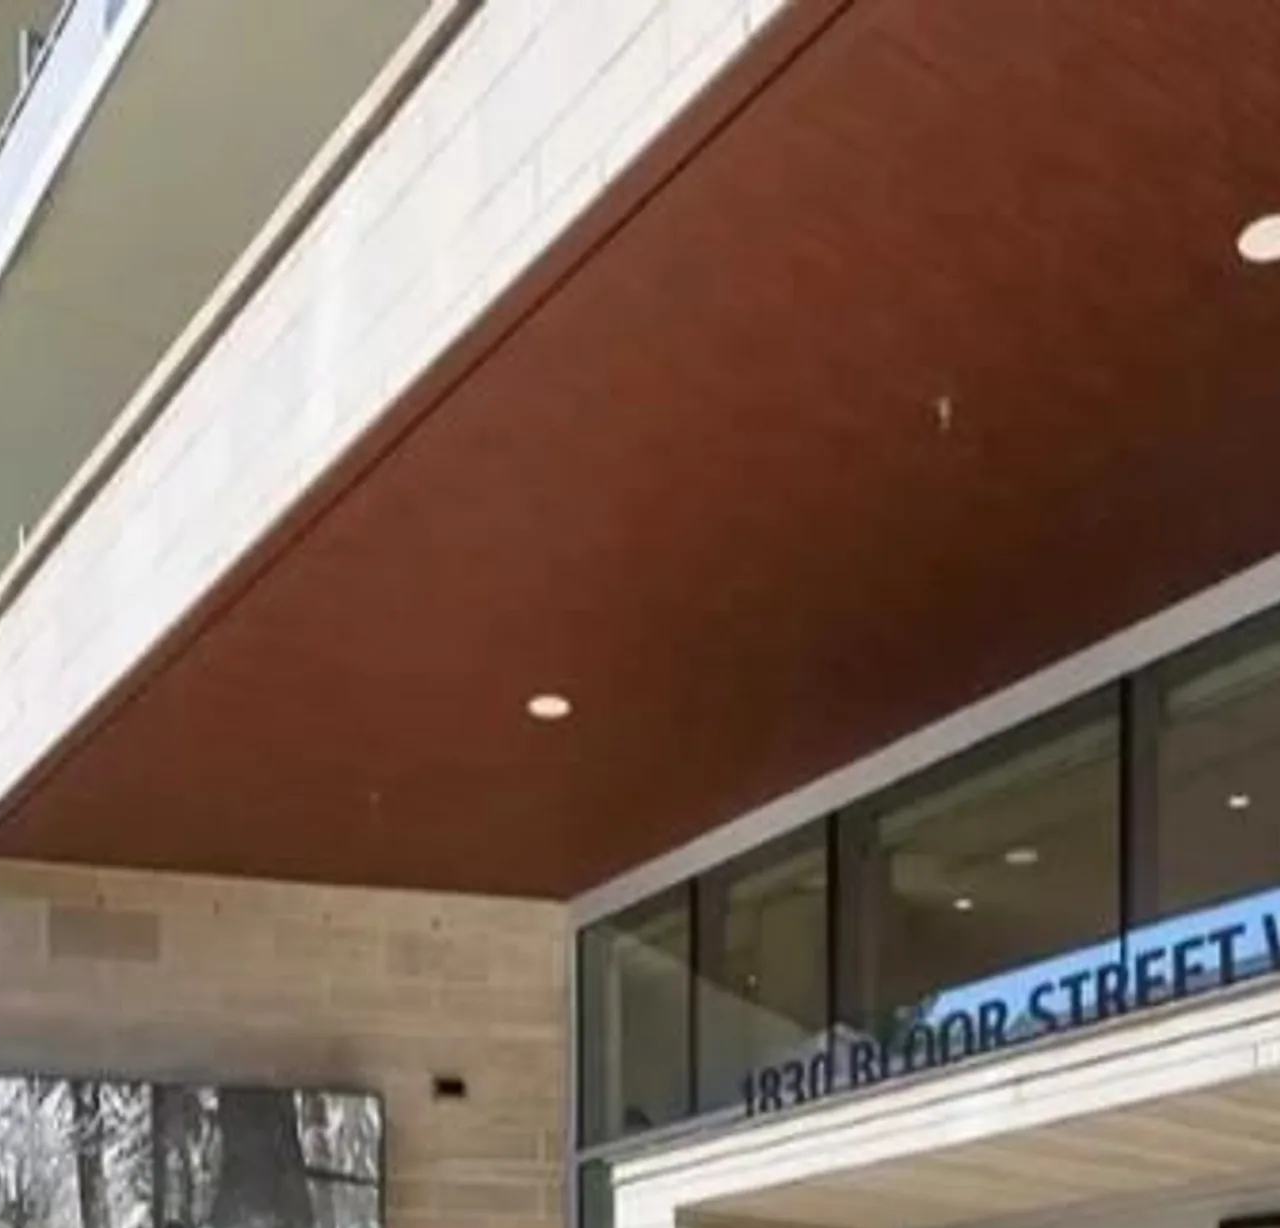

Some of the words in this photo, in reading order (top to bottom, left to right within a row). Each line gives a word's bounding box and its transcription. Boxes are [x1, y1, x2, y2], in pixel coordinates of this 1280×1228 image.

[741, 1050, 832, 1118] 1830
[849, 998, 1009, 1091] BLOOR
[1027, 922, 1248, 1036] STREET
